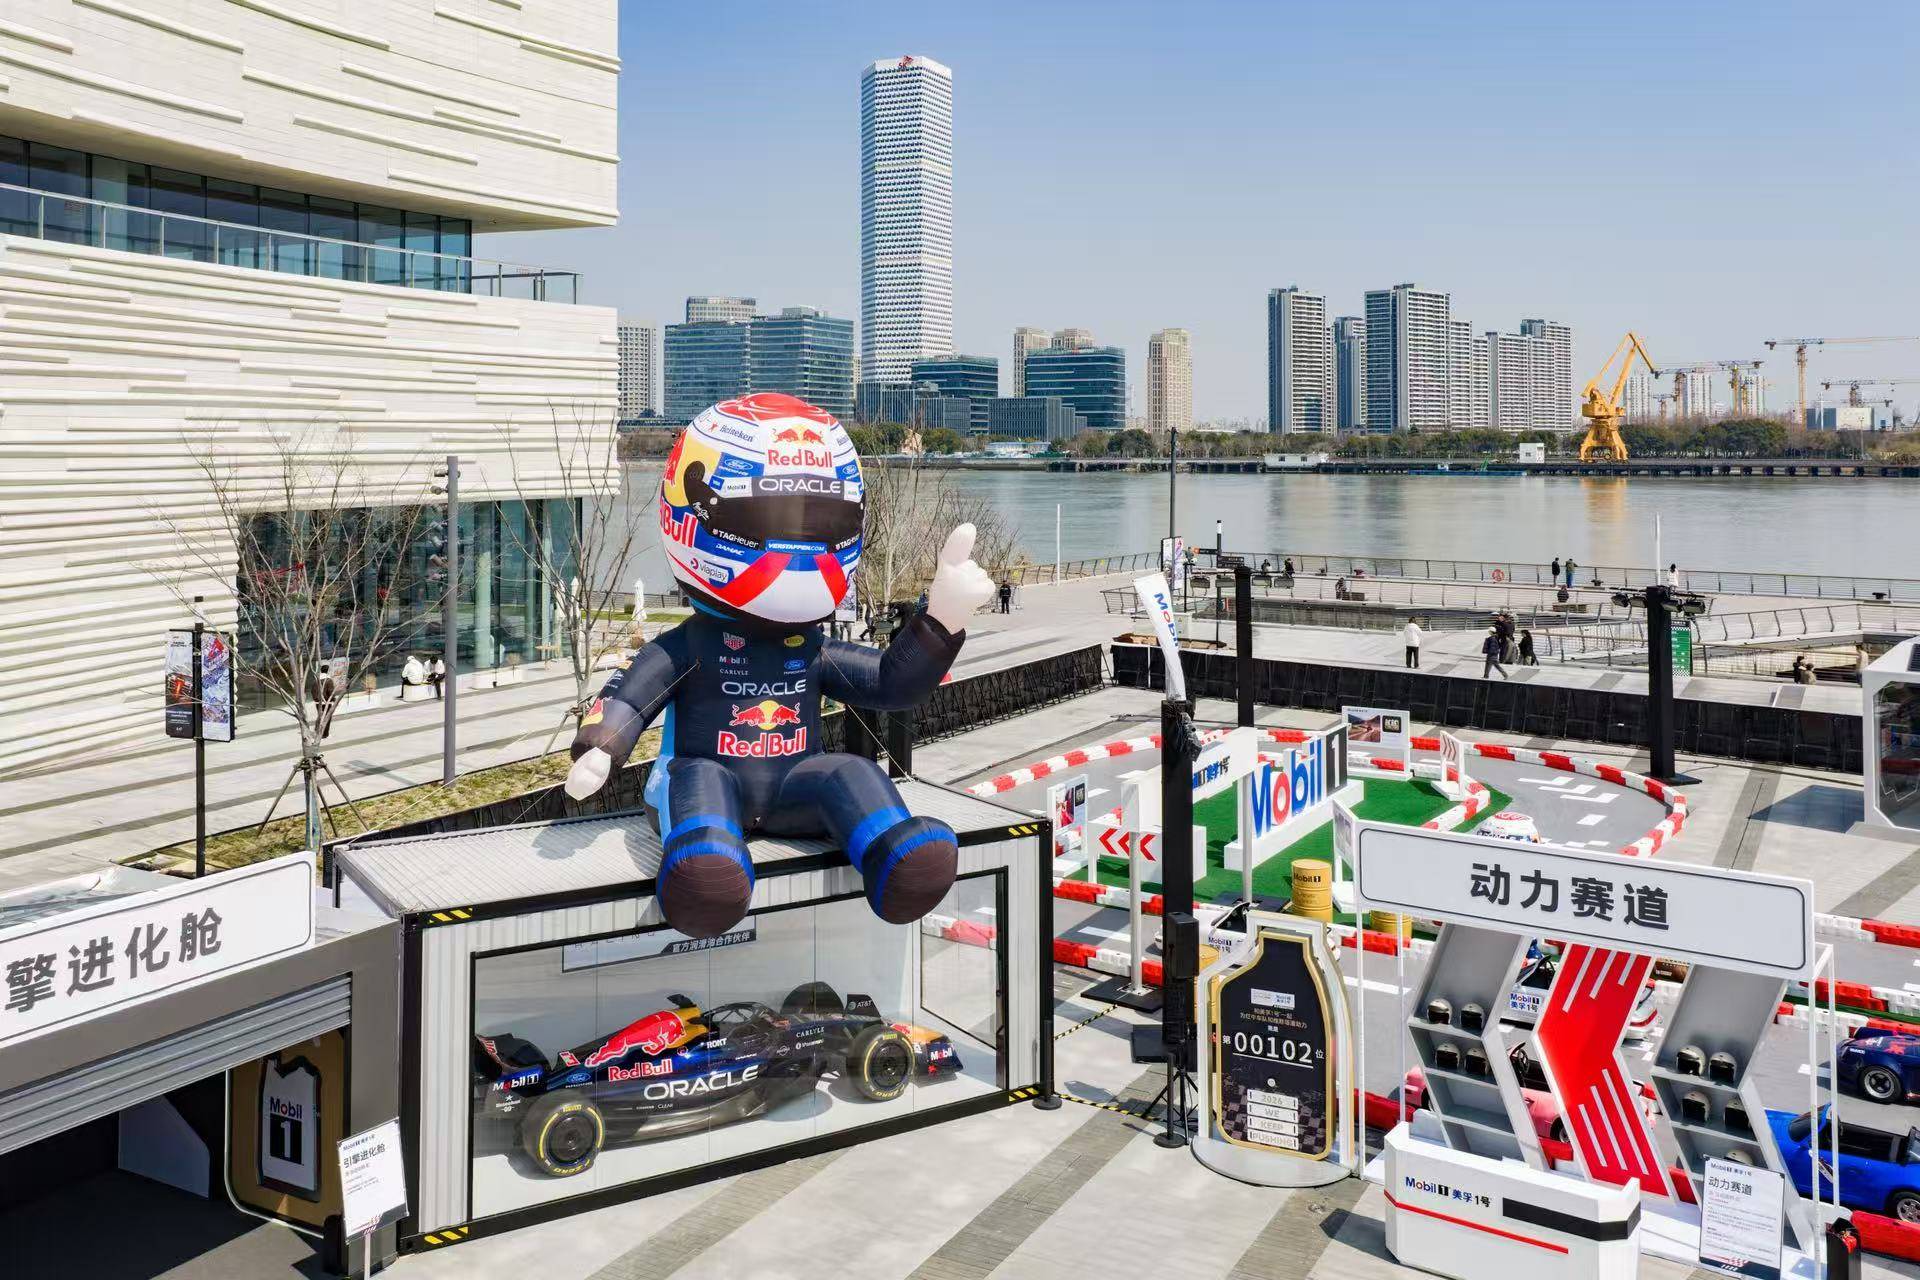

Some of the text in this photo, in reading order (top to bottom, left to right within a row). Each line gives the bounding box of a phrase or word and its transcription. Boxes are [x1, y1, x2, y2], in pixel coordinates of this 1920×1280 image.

[720, 425, 753, 442] Heineken
[768, 449, 833, 468] Red Bull
[759, 478, 840, 493] ORACLE
[719, 656, 741, 665] Mobil
[721, 679, 806, 696] ORACLE
[717, 727, 807, 757] Red Bull
[1251, 737, 1323, 840] Mobil
[1471, 863, 1670, 931] 动力赛道
[4, 907, 223, 1013] 擎进化舱
[1510, 992, 1532, 1003] Mobil
[1510, 1001, 1538, 1013] 美孚1号
[796, 1026, 825, 1038] CARLYLE
[1234, 1031, 1313, 1064] 00102
[608, 1058, 673, 1082] Red Bull
[492, 1075, 526, 1092] Mobil
[643, 1065, 760, 1101] ORACLE
[269, 1096, 303, 1119] Mobil
[1405, 1176, 1437, 1194] Mobil
[1453, 1188, 1491, 1208] 美孚1号
[1708, 1176, 1753, 1196] 动力赛道
